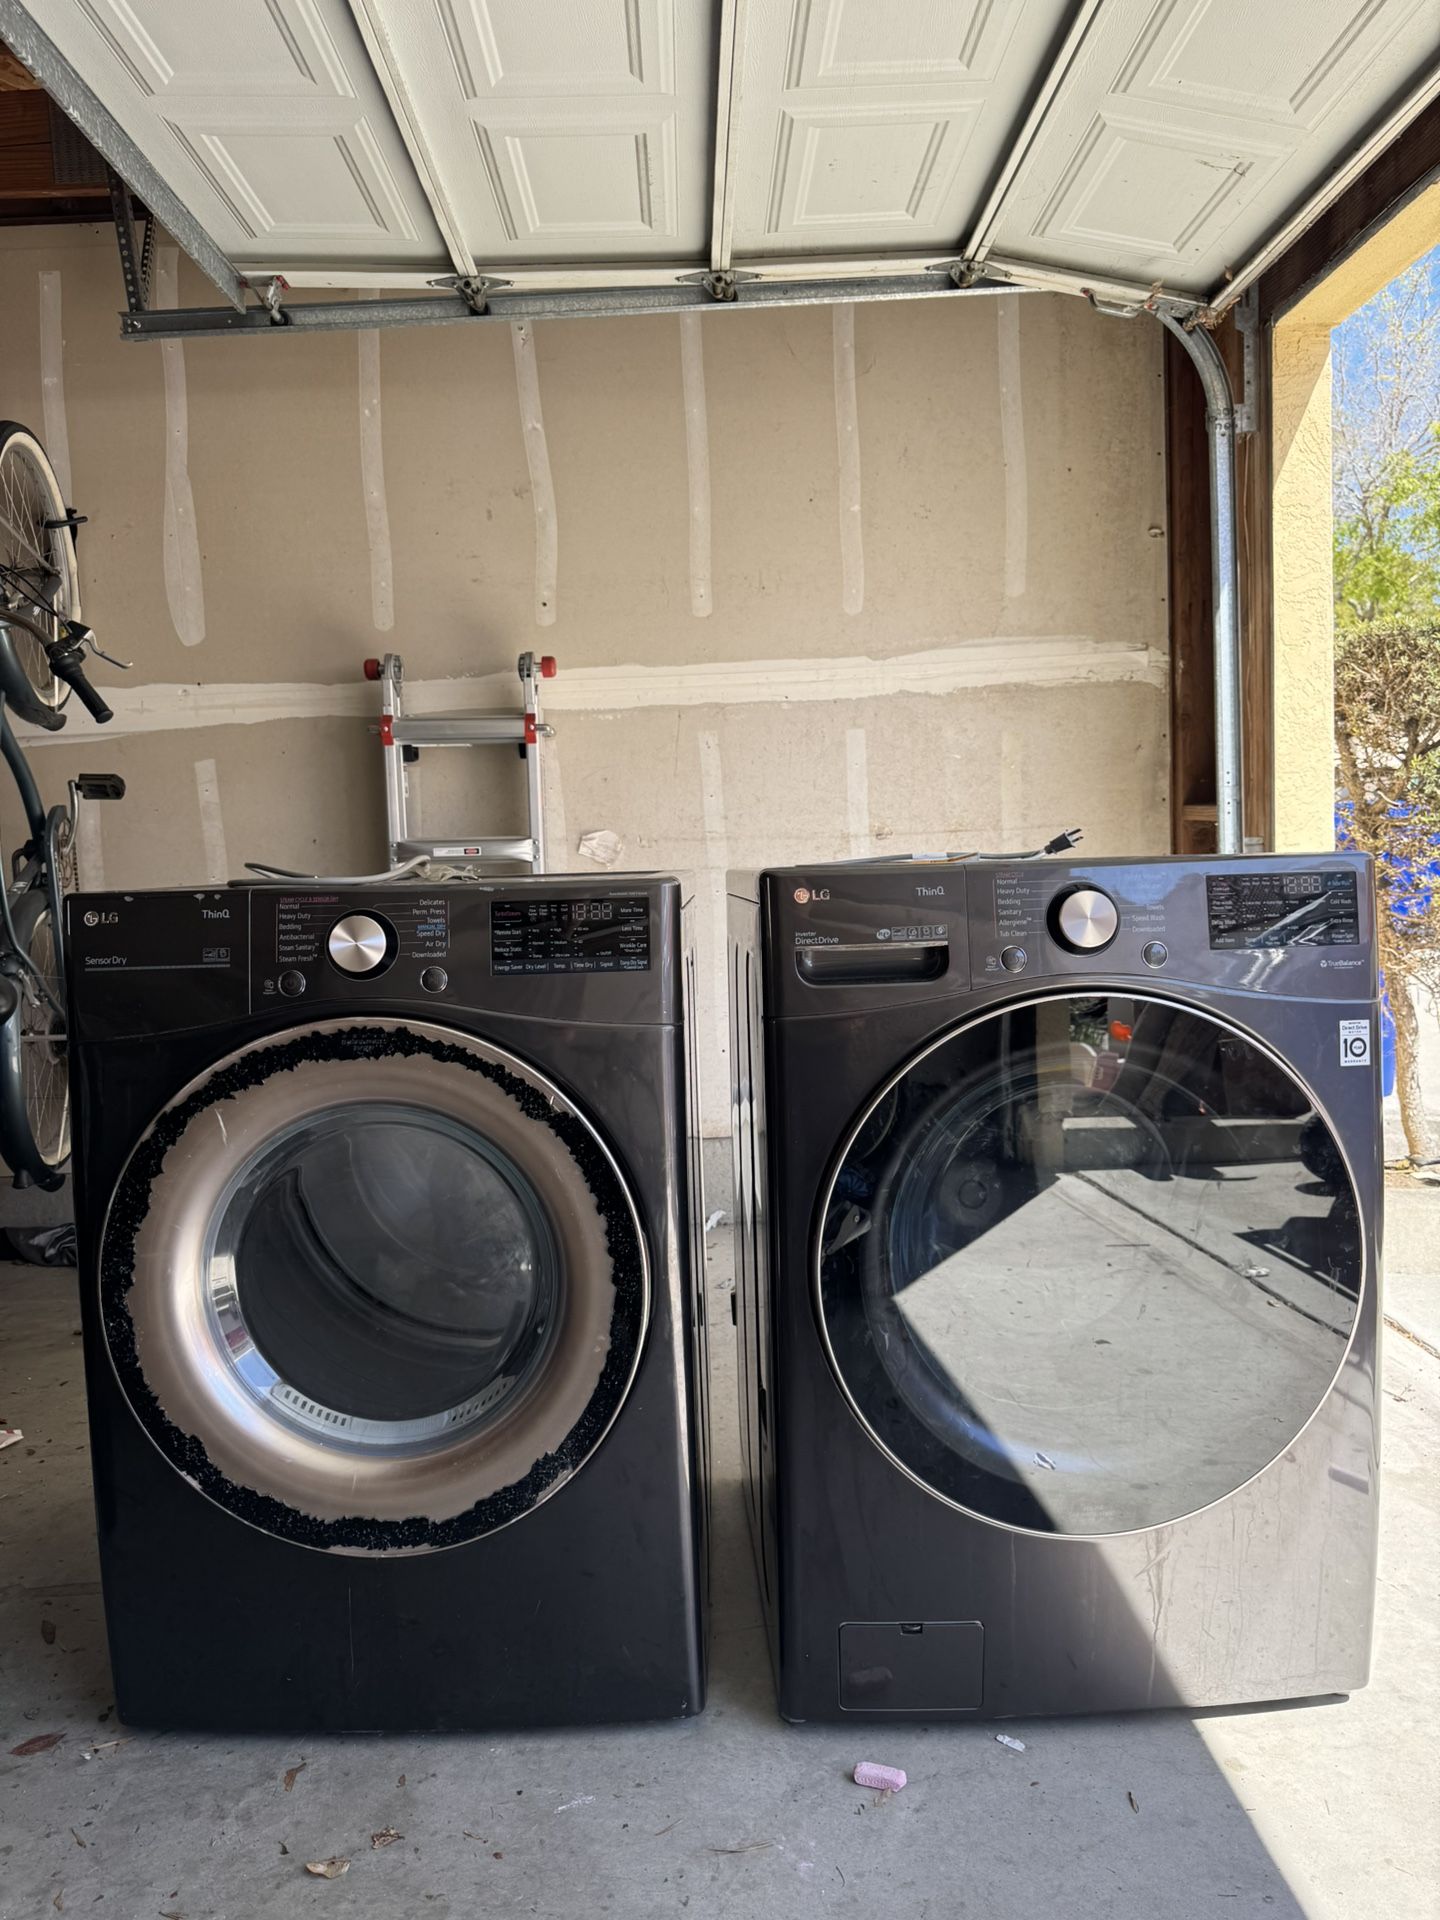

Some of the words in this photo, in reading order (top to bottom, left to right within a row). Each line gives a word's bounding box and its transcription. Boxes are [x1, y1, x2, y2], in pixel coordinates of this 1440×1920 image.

[812, 889, 831, 901] LG
[916, 886, 945, 897] ThinQ
[1016, 887, 1030, 895] Duty
[202, 909, 230, 919] ThinQ
[297, 912, 311, 920] Duty
[998, 909, 1022, 917] Sanitary
[102, 912, 119, 924] LG
[435, 930, 446, 938] Dry
[435, 940, 446, 948] Dry
[1343, 1037, 1367, 1058] 10
